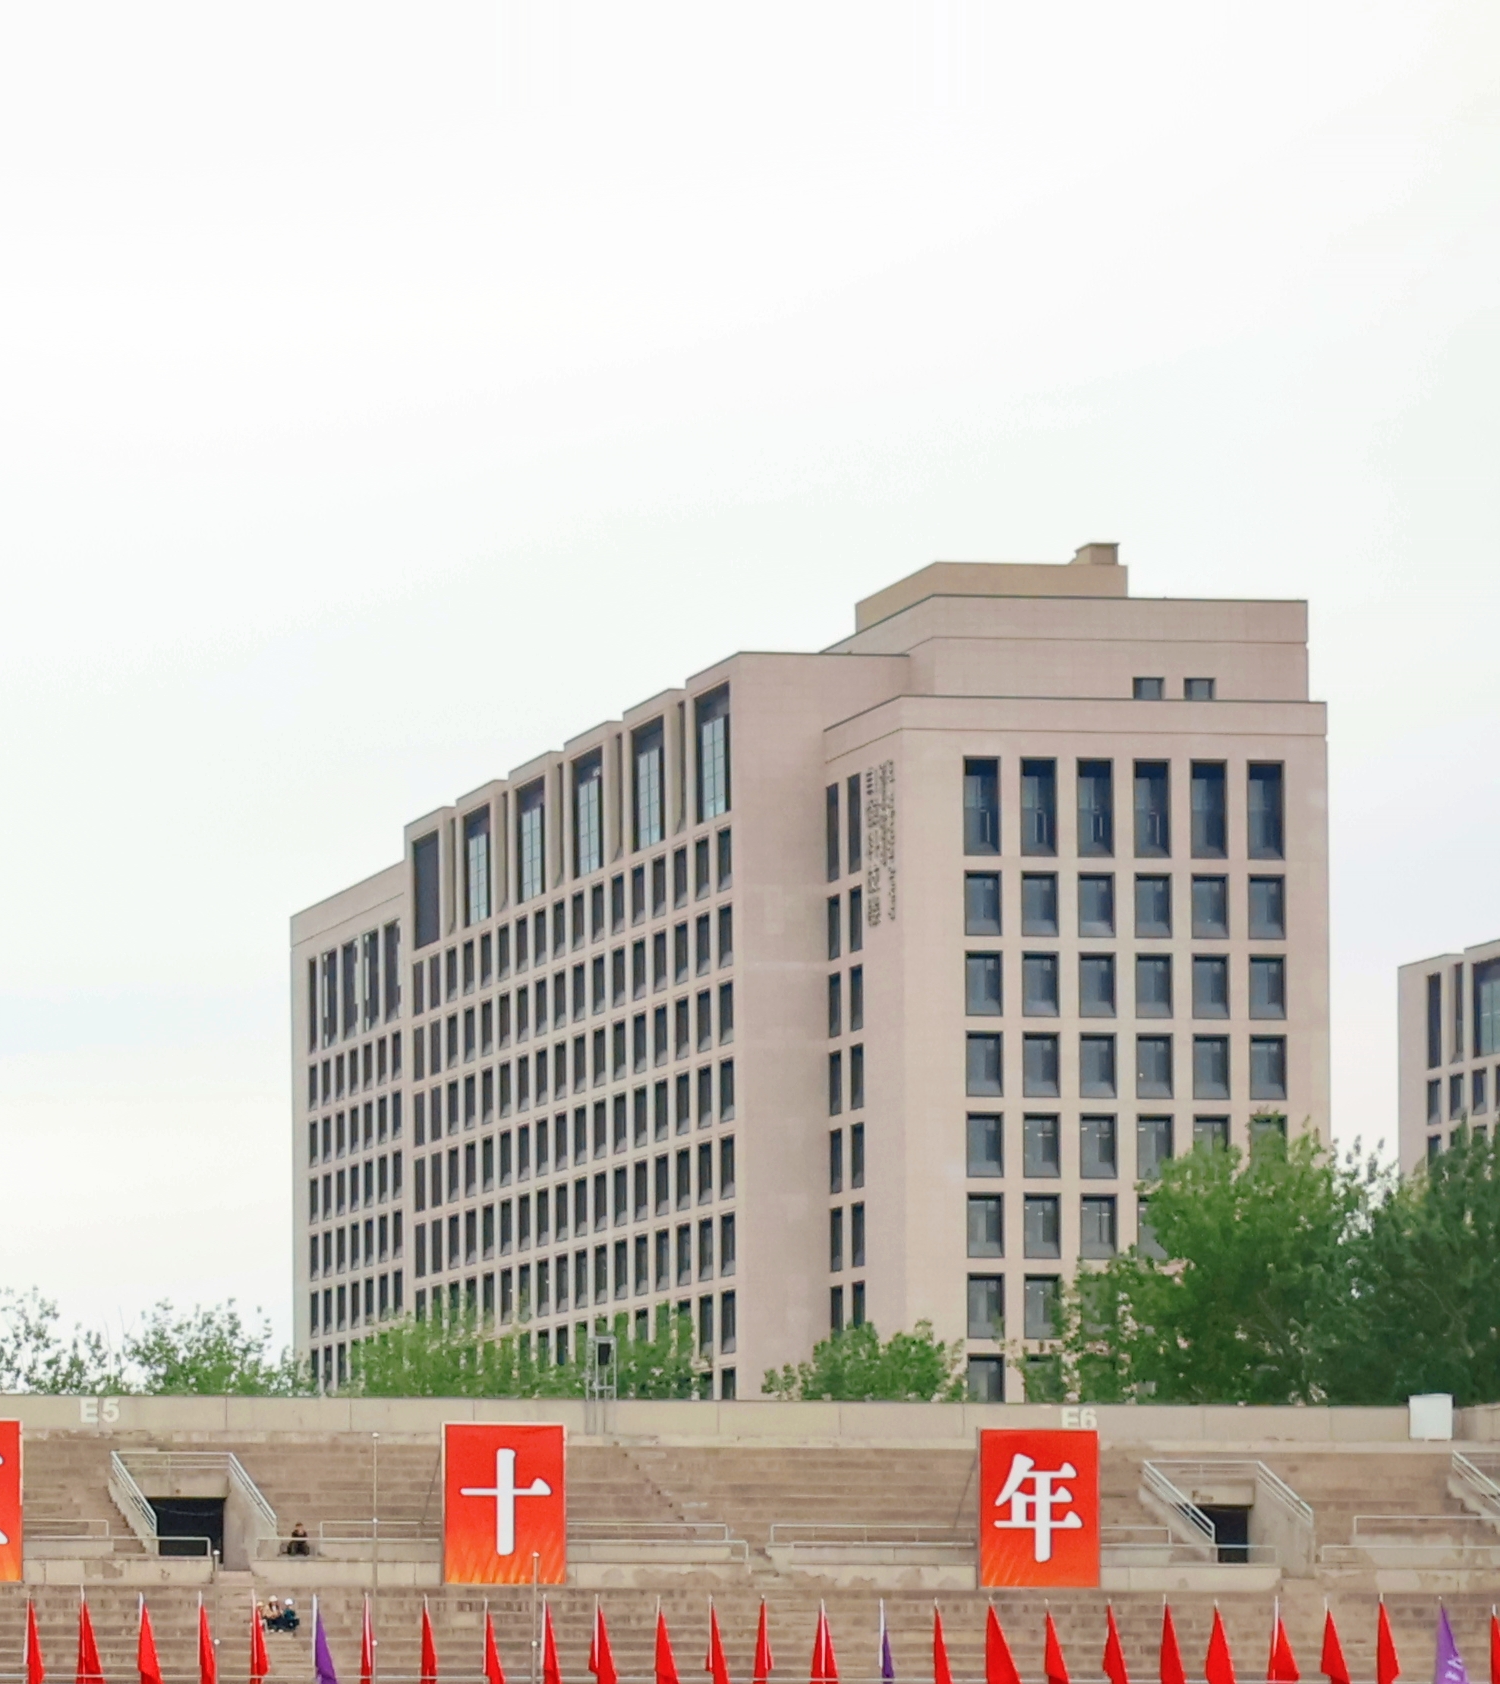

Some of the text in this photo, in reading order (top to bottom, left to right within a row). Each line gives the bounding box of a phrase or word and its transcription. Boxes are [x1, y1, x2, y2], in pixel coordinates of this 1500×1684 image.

[80, 1398, 120, 1423] E5
[1061, 1407, 1098, 1430] E6
[461, 1449, 551, 1555] 十
[995, 1454, 1082, 1562] 年
